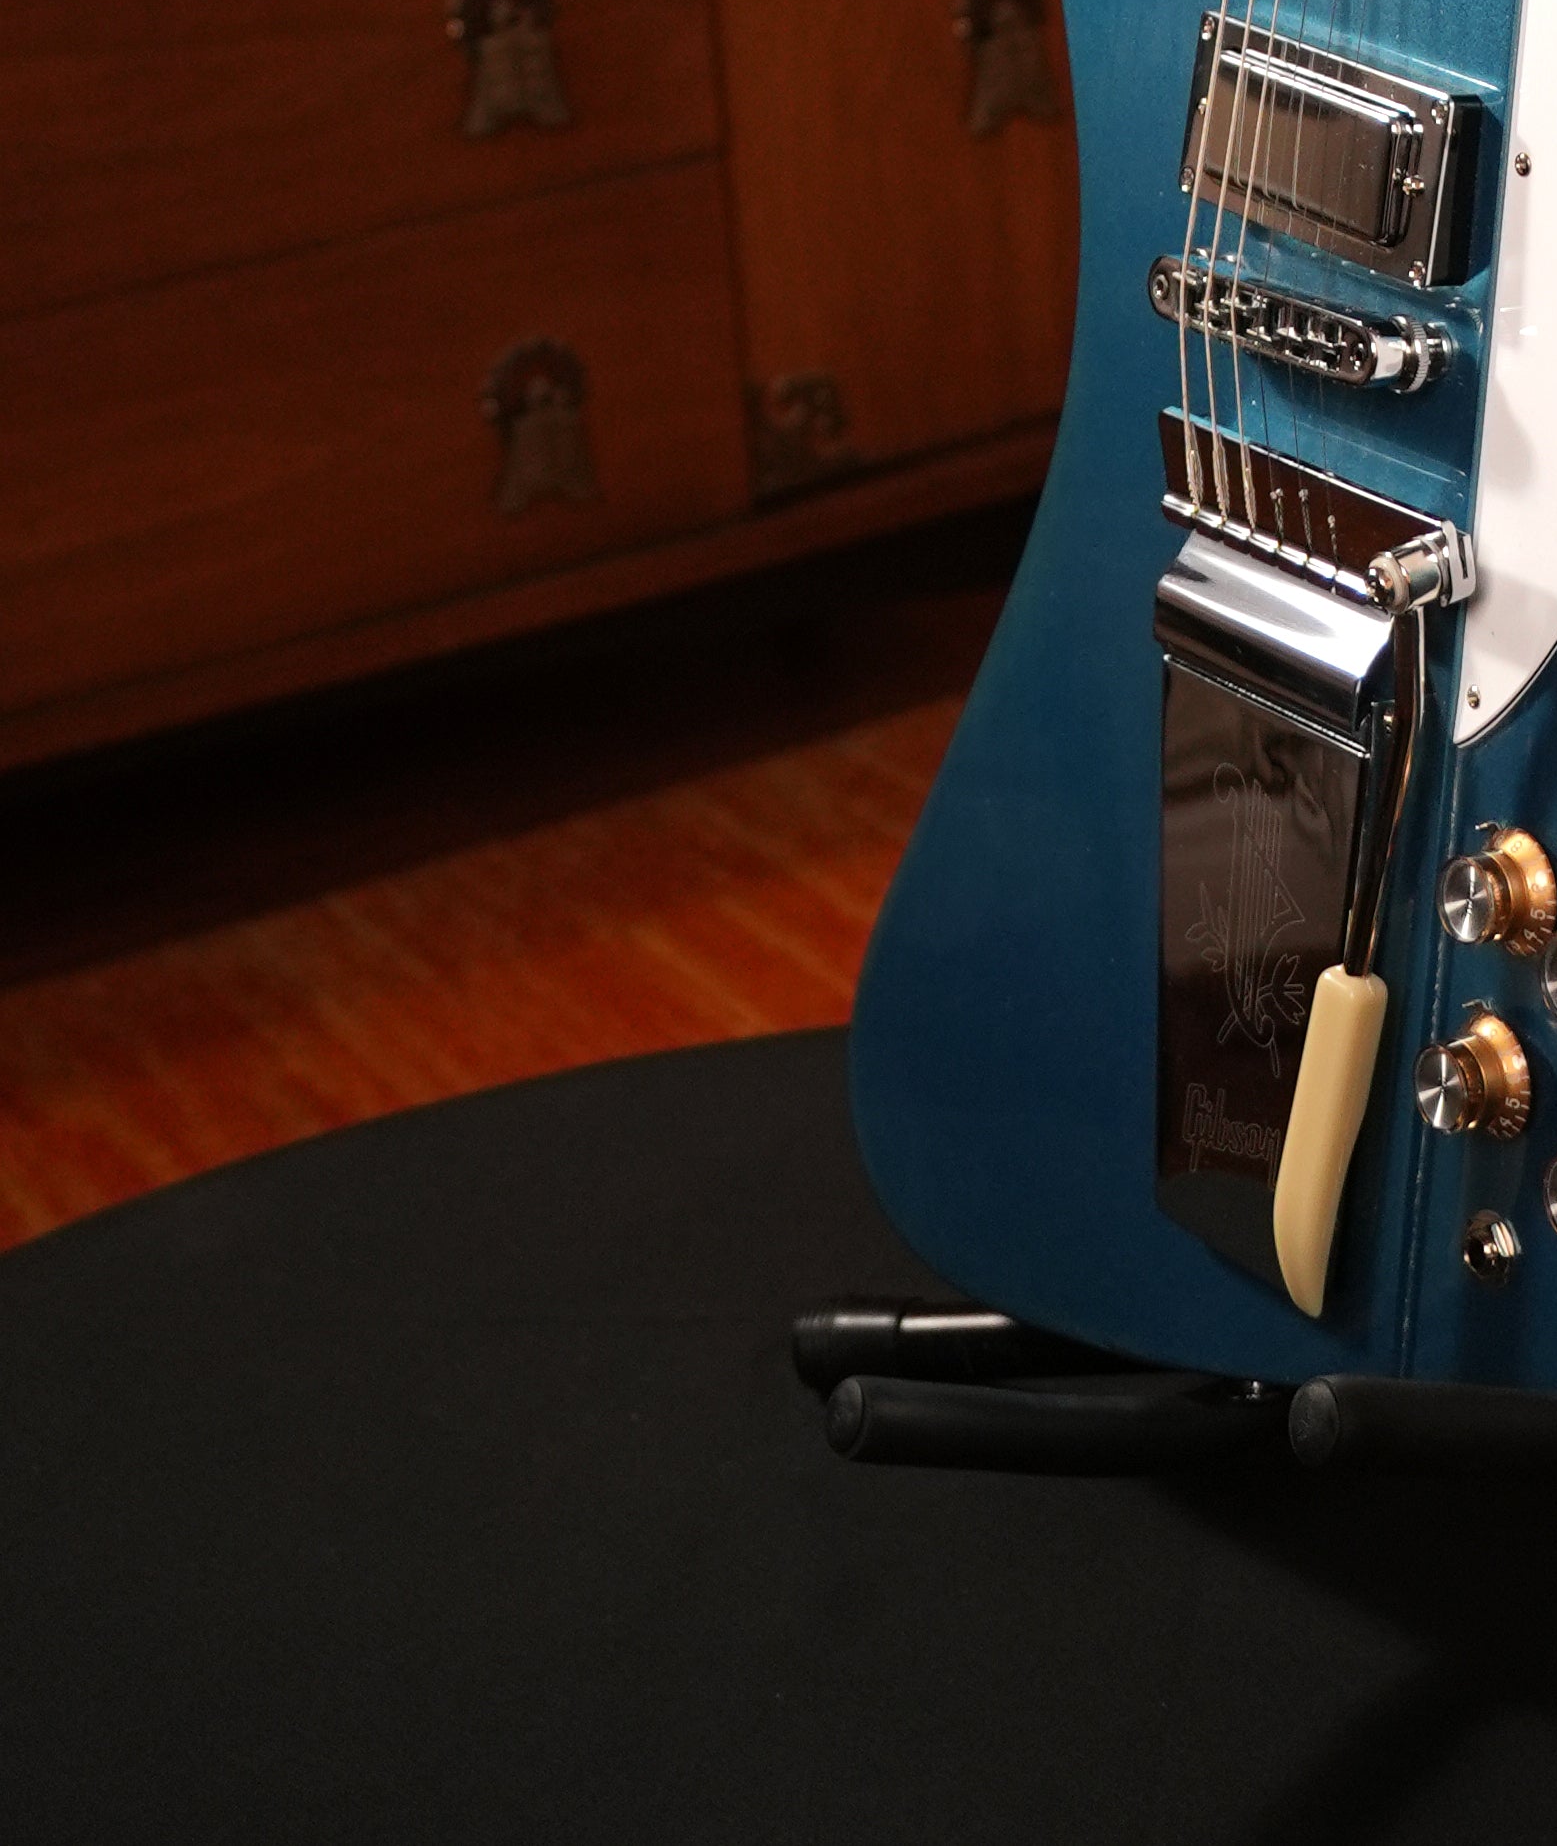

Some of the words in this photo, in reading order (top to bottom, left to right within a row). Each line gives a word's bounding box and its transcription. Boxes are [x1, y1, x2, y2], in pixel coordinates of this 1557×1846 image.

[1530, 907, 1546, 921] 5
[1523, 927, 1538, 940] 4
[1505, 1096, 1521, 1110] 5
[1182, 1082, 1281, 1191] Gibson
